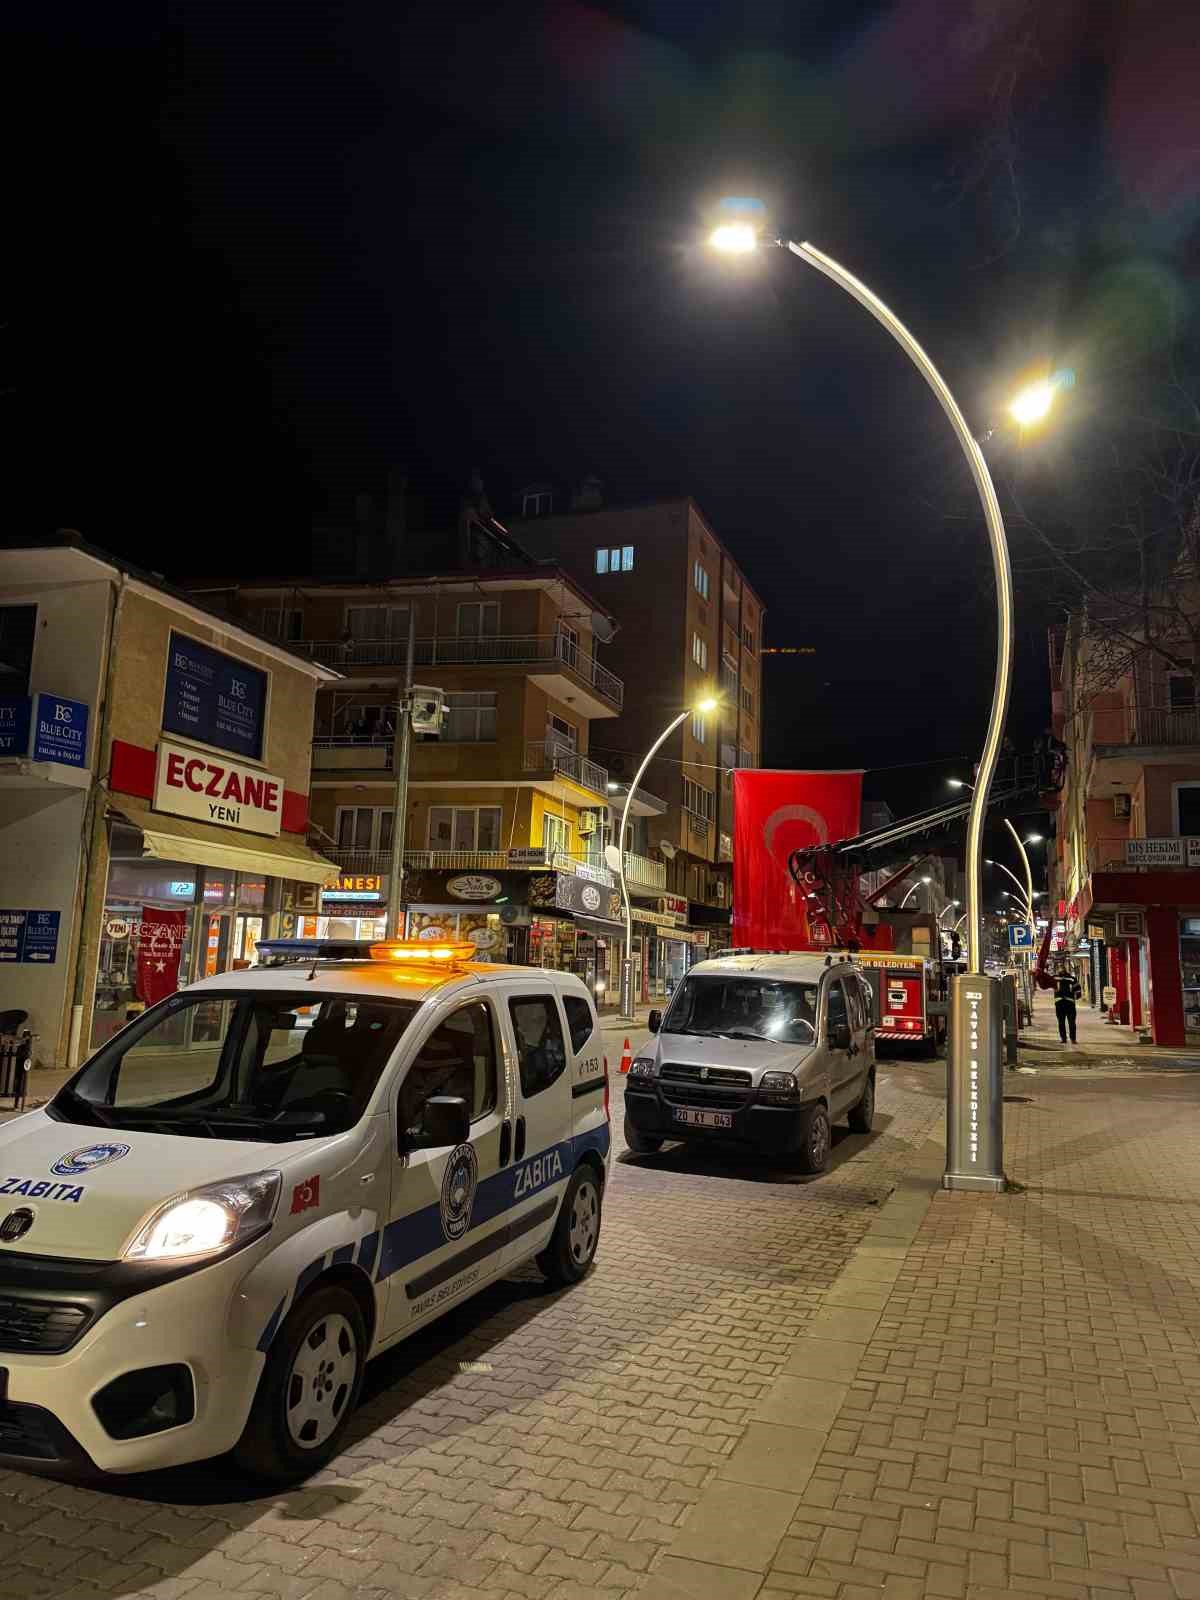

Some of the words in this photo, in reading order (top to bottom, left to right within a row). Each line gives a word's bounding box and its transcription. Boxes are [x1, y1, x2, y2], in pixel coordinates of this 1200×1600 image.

[39, 720, 62, 737] BLUE
[62, 726, 83, 741] CITY
[166, 752, 278, 812] ECZANE
[209, 803, 241, 824] YENİ
[130, 922, 189, 940] ECZANE
[1013, 927, 1026, 945] P
[970, 1001, 978, 1050] TAVAS
[584, 1057, 599, 1073] 153
[677, 1110, 688, 1121] 20
[694, 1112, 705, 1123] KY
[514, 1150, 563, 1199] ZABITA
[0, 1178, 85, 1203] ZABITA
